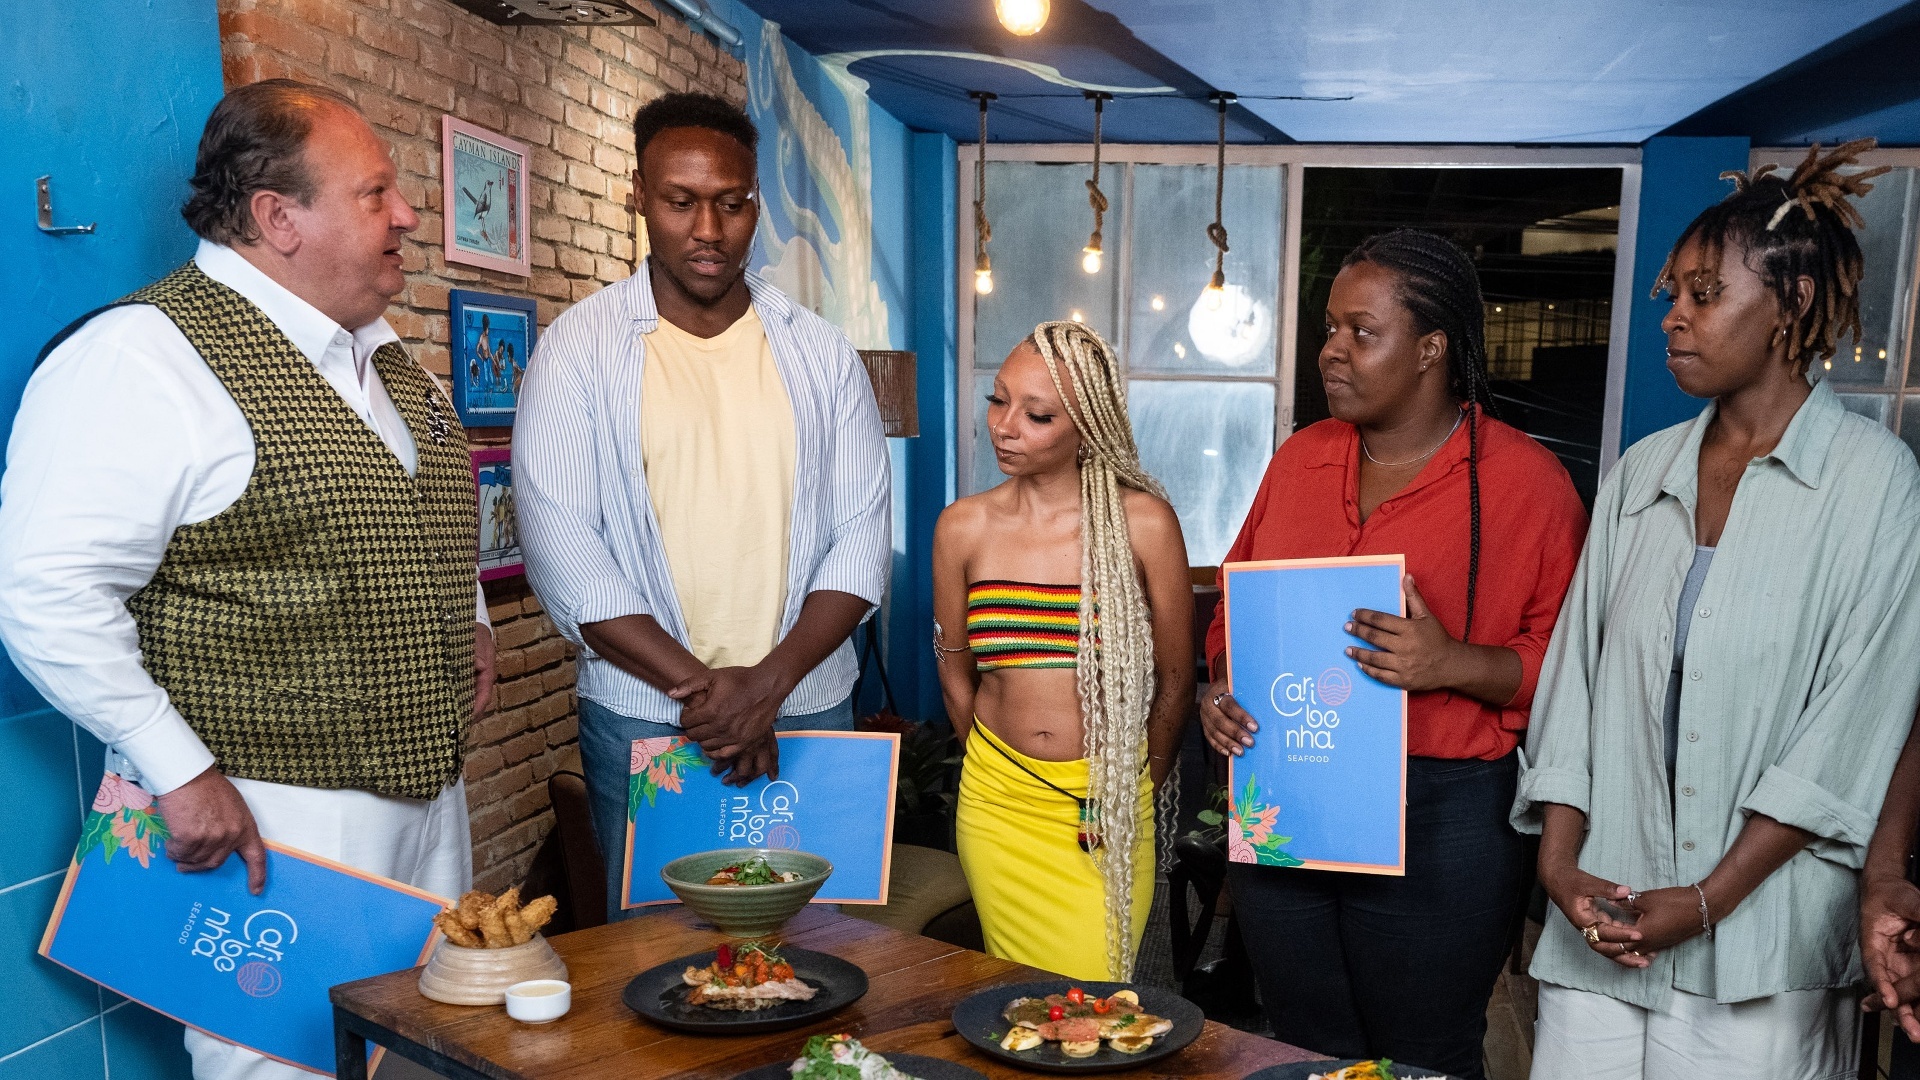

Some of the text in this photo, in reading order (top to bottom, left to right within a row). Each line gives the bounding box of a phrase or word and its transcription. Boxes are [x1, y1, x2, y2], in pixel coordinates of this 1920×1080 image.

[453, 135, 520, 171] CAYMAN ISLANDS
[1287, 754, 1330, 763] SEAFOOD
[718, 798, 727, 837] SEAFOOD
[178, 901, 203, 945] SEAFOOD
